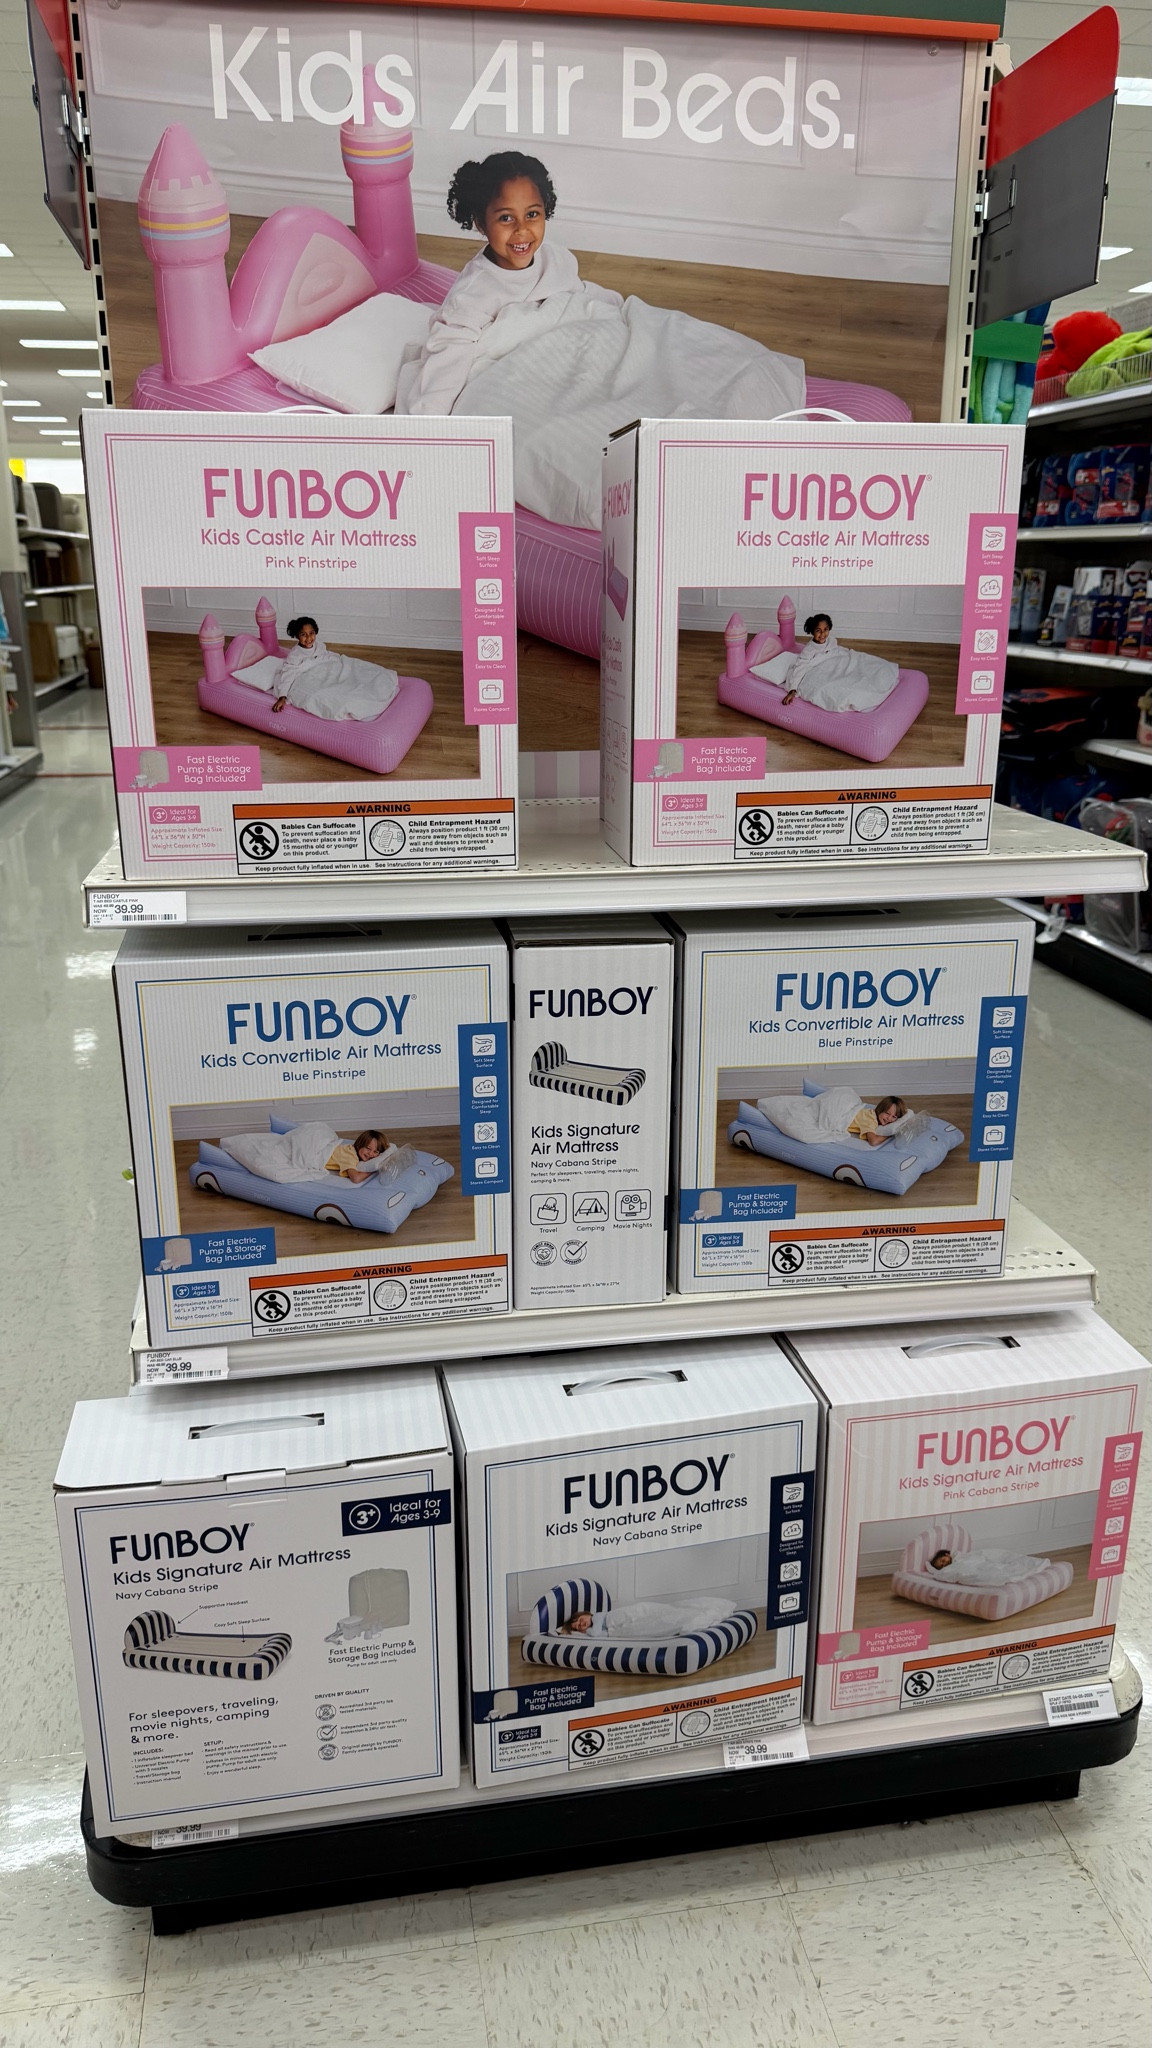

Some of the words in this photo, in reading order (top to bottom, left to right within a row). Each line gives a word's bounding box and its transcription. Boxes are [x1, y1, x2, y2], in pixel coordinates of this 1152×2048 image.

[209, 22, 416, 129] Kids
[450, 38, 585, 137] Air
[620, 45, 857, 150] Beds.
[203, 468, 408, 520] FUNBOY
[743, 473, 927, 521] FUNBOY
[201, 529, 240, 547] Kids
[245, 529, 305, 547] Castle
[311, 530, 335, 547] Air
[341, 530, 417, 548] Mattress
[736, 531, 773, 547] Kids
[776, 531, 830, 547] Castle
[835, 531, 857, 546] Air
[861, 531, 930, 547] Mattress
[265, 556, 295, 569] Pink
[298, 556, 357, 571] Pinstripe
[791, 557, 818, 568] Pink
[821, 556, 874, 570] Pinstripe
[700, 746, 718, 756] Fast
[720, 745, 748, 755] Electric
[187, 756, 205, 764] Fast
[208, 756, 240, 764] Electric
[691, 755, 714, 766] Pump
[717, 755, 723, 763] &
[725, 754, 757, 765] Storage
[178, 766, 205, 775] Pump
[216, 766, 251, 774] Storage
[696, 765, 712, 775] Bag
[714, 763, 752, 772] Included
[184, 776, 202, 784] Bag
[205, 775, 246, 783] Included
[847, 791, 896, 800] WARNING
[356, 804, 411, 813] WARNING
[114, 904, 144, 913] 39.99
[775, 967, 942, 1012] FUNBOY
[529, 986, 654, 1019] FUNBOY
[227, 994, 411, 1044] FUNBOY
[749, 1020, 780, 1034] Kids
[785, 1015, 873, 1032] Convertible
[877, 1015, 898, 1028] Air
[902, 1013, 965, 1027] Mattress
[818, 1037, 843, 1048] Blue
[845, 1036, 893, 1049] Pinstripe
[200, 1052, 237, 1069] Kids
[242, 1045, 341, 1066] Convertible
[346, 1044, 369, 1059] Air
[373, 1040, 442, 1057] Mattress
[282, 1068, 309, 1082] Blue
[312, 1066, 366, 1082] Pinstripe
[531, 1125, 563, 1139] Kids
[567, 1122, 641, 1138] Signature
[531, 1142, 551, 1155] Air
[555, 1140, 619, 1154] Mattress
[531, 1161, 553, 1169] Navy
[592, 1158, 616, 1166] Stripe
[870, 1226, 916, 1235] WARNING
[199, 1247, 224, 1257] Pump
[235, 1242, 267, 1254] Storage
[207, 1238, 226, 1248] Fast
[228, 1235, 257, 1246] Electric
[205, 1254, 222, 1265] Bag
[224, 1252, 262, 1262] Included
[362, 1265, 412, 1276] WARNING
[166, 1362, 192, 1372] 39.99
[917, 1416, 1071, 1469] FUNBOY
[899, 1475, 929, 1490] Kids
[933, 1468, 1001, 1488] Signature
[1005, 1463, 1024, 1476] Air
[1028, 1455, 1083, 1473] Mattress
[564, 1454, 729, 1514] FUNBOY
[943, 1489, 965, 1500] Pink
[967, 1483, 1008, 1497] Cabana
[1011, 1479, 1040, 1492] Stripe
[389, 1499, 422, 1513] Ideal
[424, 1497, 442, 1509] for
[391, 1510, 421, 1524] Ages
[423, 1508, 441, 1519] 3-9
[546, 1521, 578, 1537] Kids
[582, 1512, 657, 1534] Signature
[661, 1505, 682, 1519] Air
[686, 1496, 748, 1516] Mattress
[592, 1534, 621, 1547] Navy
[624, 1527, 668, 1542] Cabana
[671, 1522, 702, 1537] Stripe
[109, 1523, 250, 1565] FUNBOY
[113, 1567, 151, 1585] Kids
[156, 1559, 243, 1582] Signature
[249, 1555, 272, 1571] Air
[278, 1546, 351, 1568] Mattress
[115, 1589, 143, 1602] Navy
[144, 1584, 186, 1598] Cabana
[188, 1581, 219, 1594] Stripe
[328, 1655, 360, 1663] Storage
[381, 1647, 416, 1657] Included
[349, 1644, 380, 1653] Electric
[382, 1641, 406, 1649] Pump
[996, 1642, 1037, 1655] WARNING
[129, 1713, 147, 1722] For
[151, 1704, 218, 1718] sleepovers,
[222, 1697, 279, 1710] traveling,
[670, 1697, 717, 1711] WARNING
[130, 1721, 167, 1733] movie
[171, 1716, 212, 1729] nights,
[216, 1709, 269, 1722] camping
[131, 1736, 140, 1744] &
[144, 1732, 179, 1742] more.
[745, 1744, 767, 1754] 39.99
